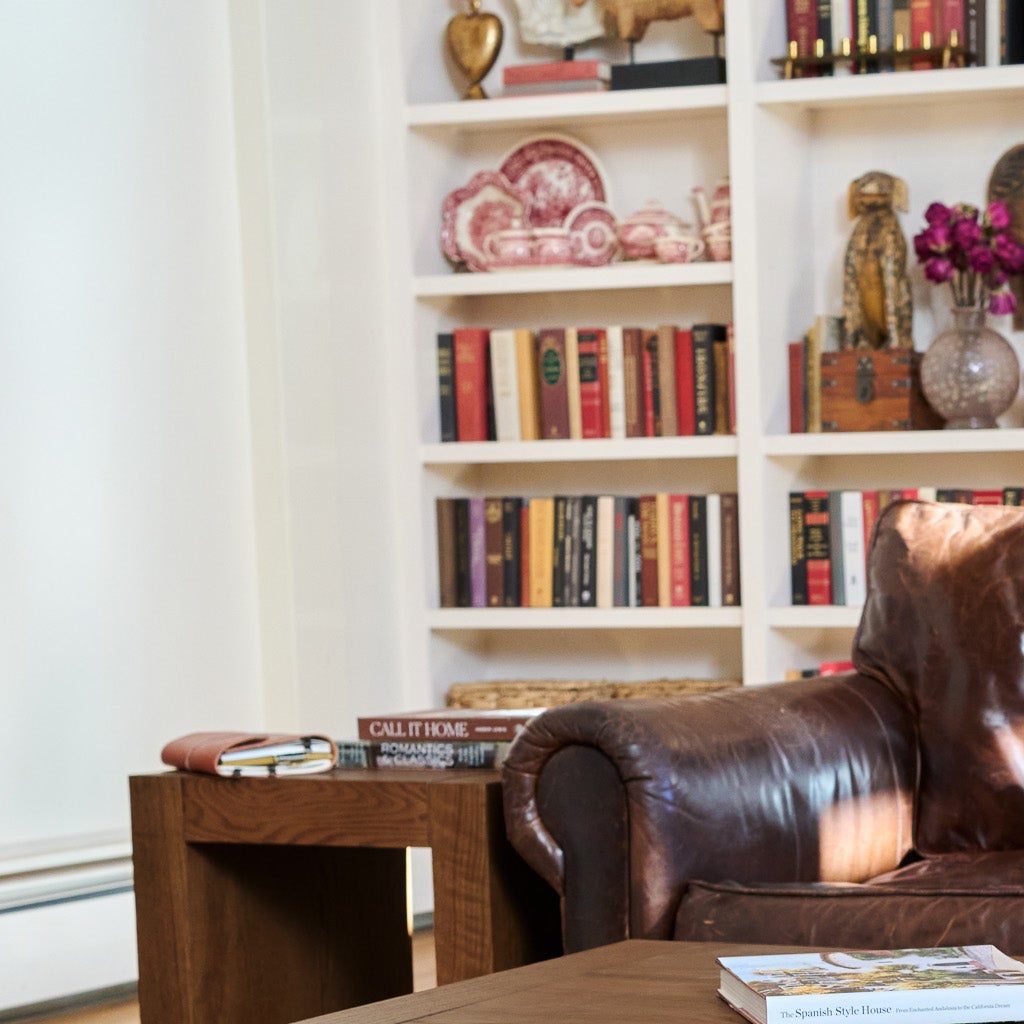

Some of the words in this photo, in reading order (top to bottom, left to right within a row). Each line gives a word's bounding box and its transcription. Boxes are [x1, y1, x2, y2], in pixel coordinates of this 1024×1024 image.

[369, 721, 406, 738] CALL
[408, 721, 424, 738] IT
[425, 721, 470, 738] HOME
[780, 1011, 794, 1019] The
[795, 1007, 833, 1020] Spanish
[835, 1005, 860, 1018] Style
[862, 1005, 892, 1015] House
